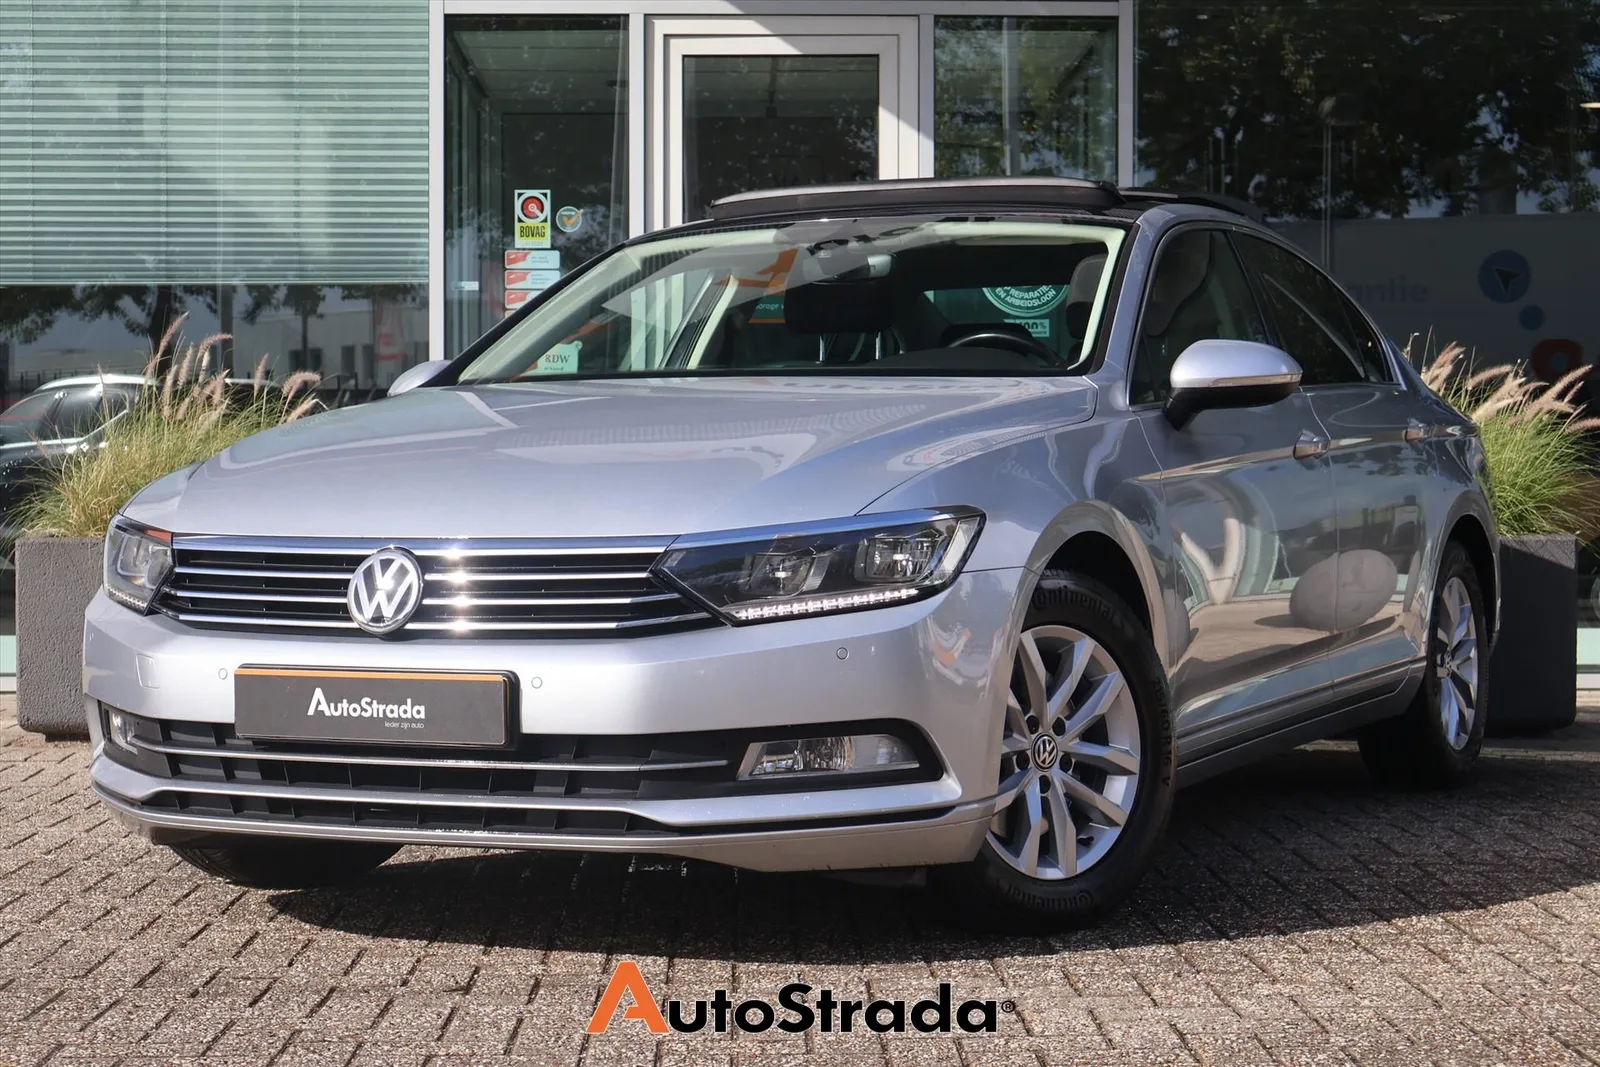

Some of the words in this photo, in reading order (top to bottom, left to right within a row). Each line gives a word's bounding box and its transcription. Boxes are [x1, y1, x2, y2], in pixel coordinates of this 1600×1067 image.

[519, 225, 546, 238] BOVAG
[995, 287, 1007, 298] EN
[1004, 289, 1057, 306] ARBEIDSLOON
[306, 687, 426, 719] AutoStrada
